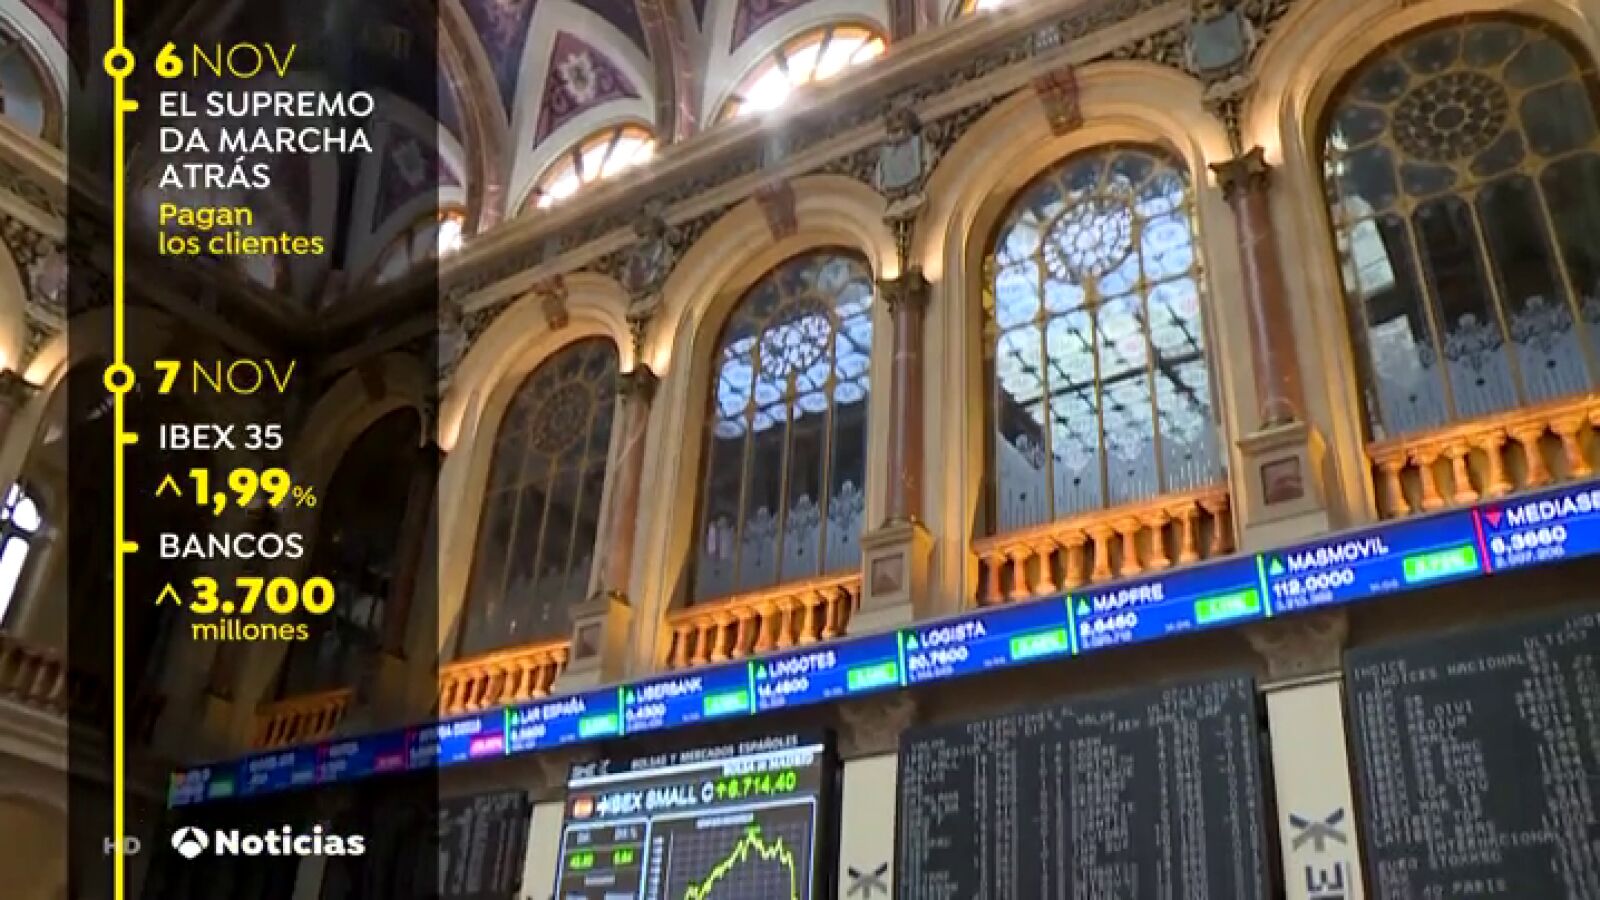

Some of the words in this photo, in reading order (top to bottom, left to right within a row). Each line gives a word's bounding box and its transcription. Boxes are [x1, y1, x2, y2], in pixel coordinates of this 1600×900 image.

[1287, 536, 1389, 573] MASMOVIL
[1093, 583, 1164, 612] MAPFRE
[920, 620, 987, 647] LOGISTA
[768, 650, 837, 678] LINGOTES
[645, 785, 698, 811] SMALL
